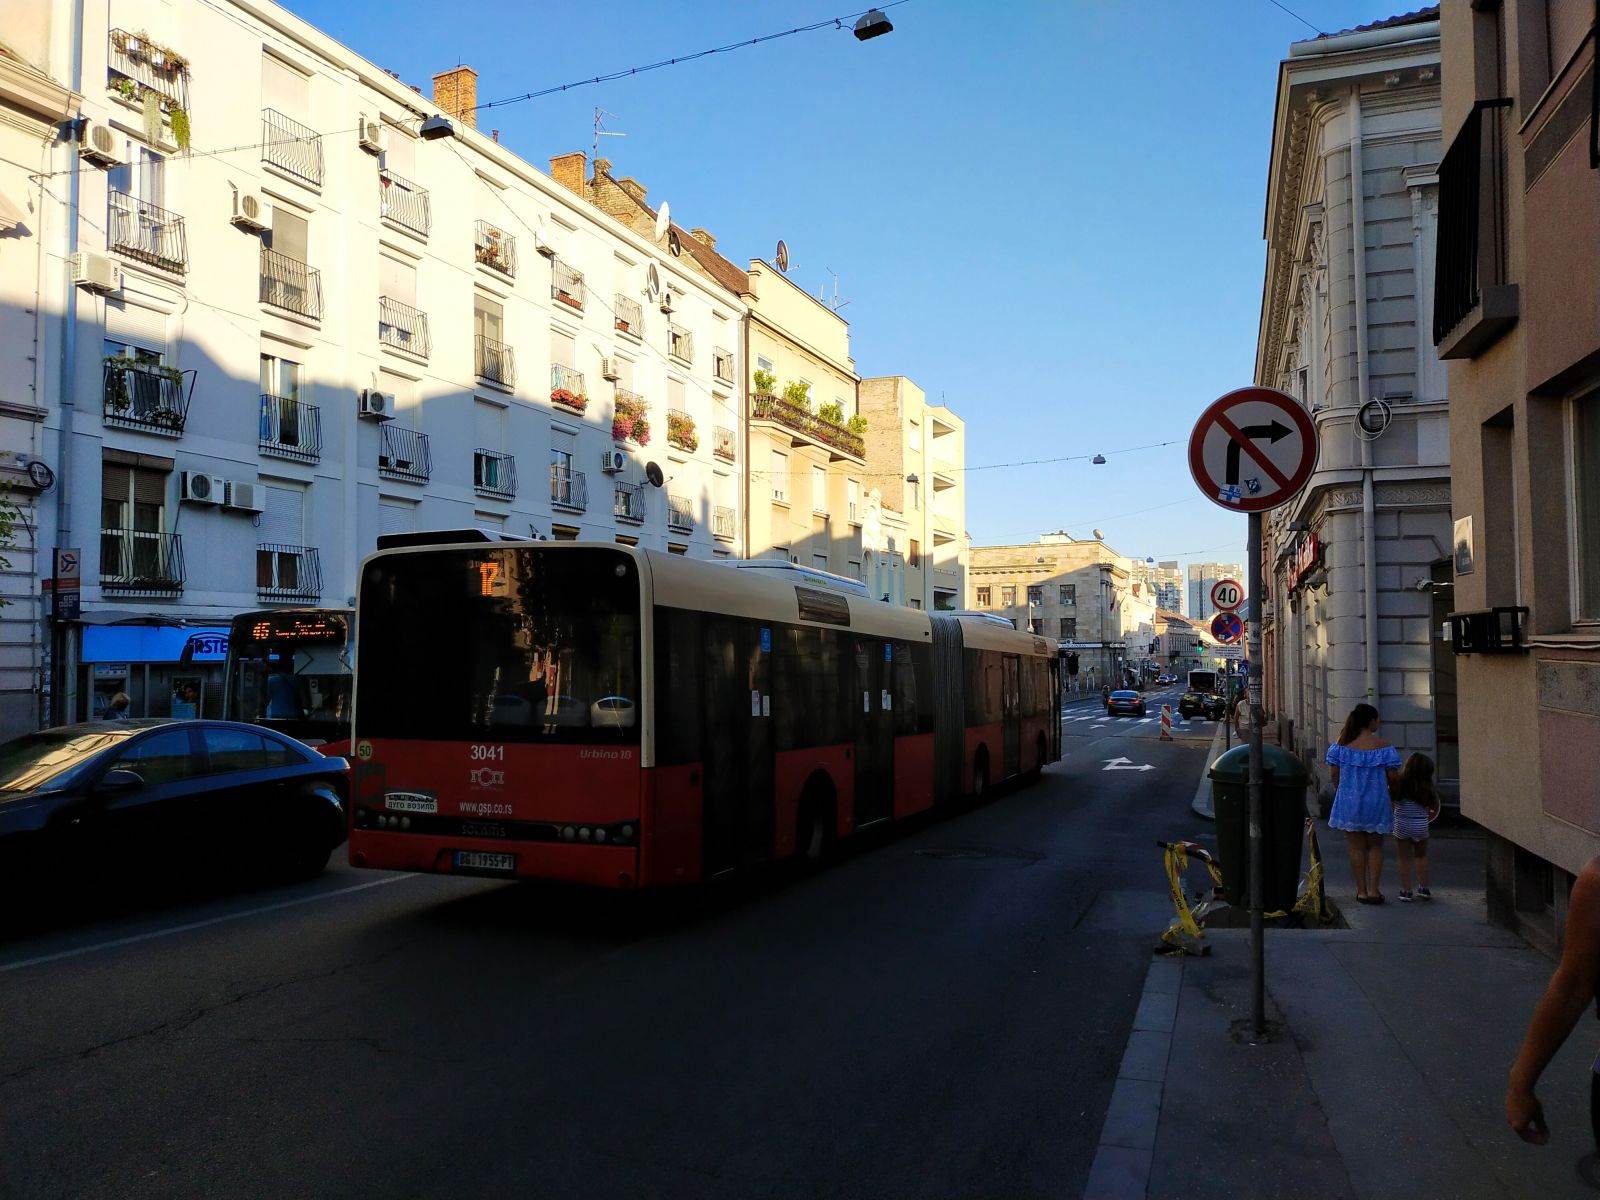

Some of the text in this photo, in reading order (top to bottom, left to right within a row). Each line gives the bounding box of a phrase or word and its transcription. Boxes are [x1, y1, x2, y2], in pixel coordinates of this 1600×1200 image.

[1217, 587, 1238, 604] 40
[360, 745, 371, 757] 50
[470, 744, 505, 761] 3041
[459, 802, 513, 816] www.gsp.co.rs
